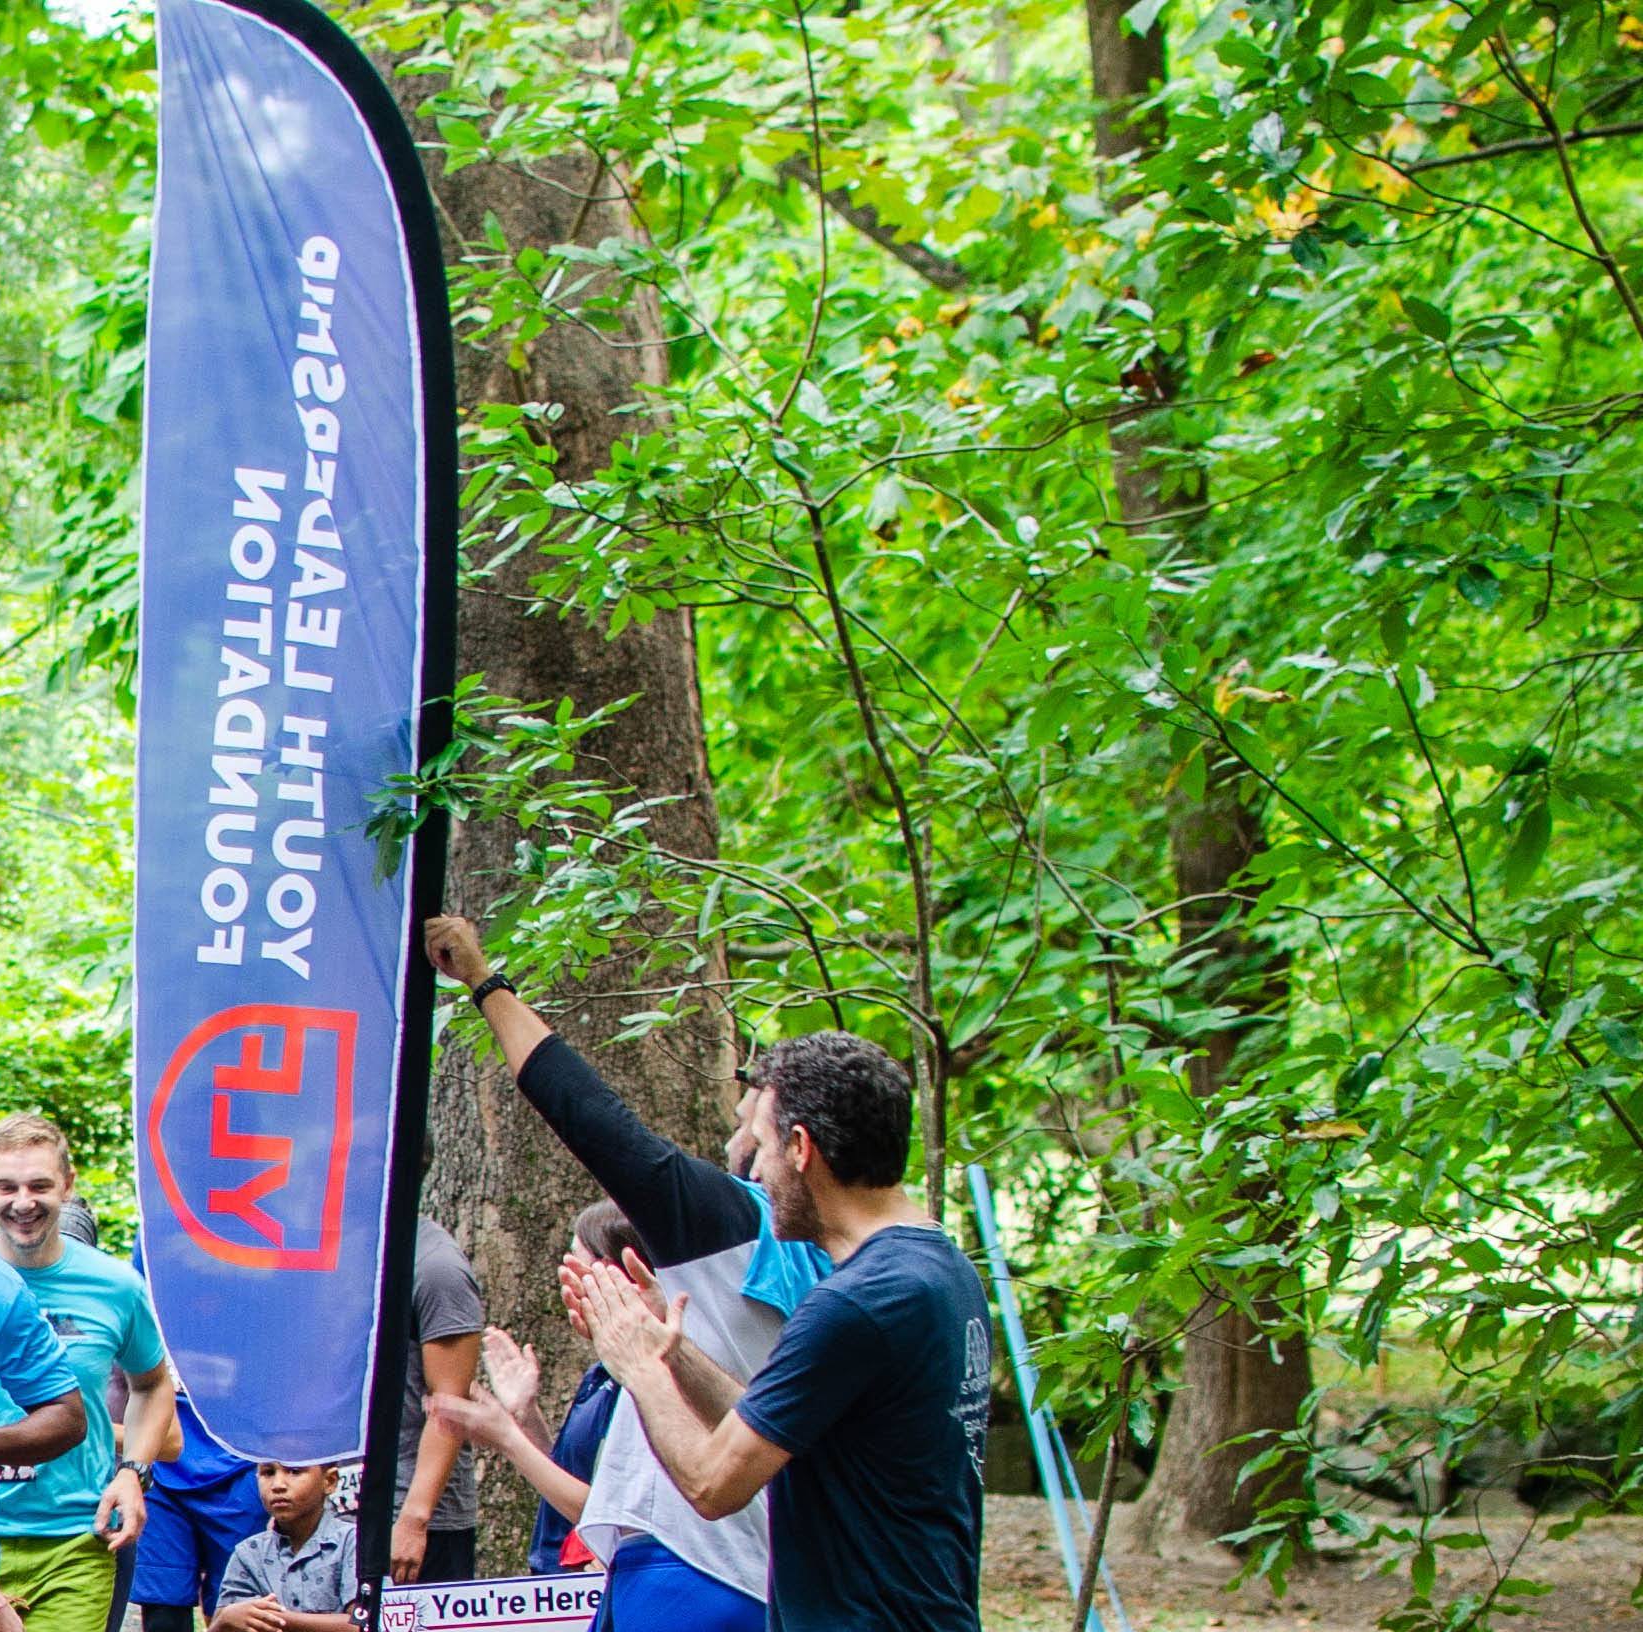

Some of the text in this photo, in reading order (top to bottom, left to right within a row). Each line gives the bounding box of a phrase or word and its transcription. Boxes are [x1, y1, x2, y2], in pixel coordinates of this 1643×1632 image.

[431, 1585, 603, 1620] You're Here
[385, 1611, 414, 1628] YLF
